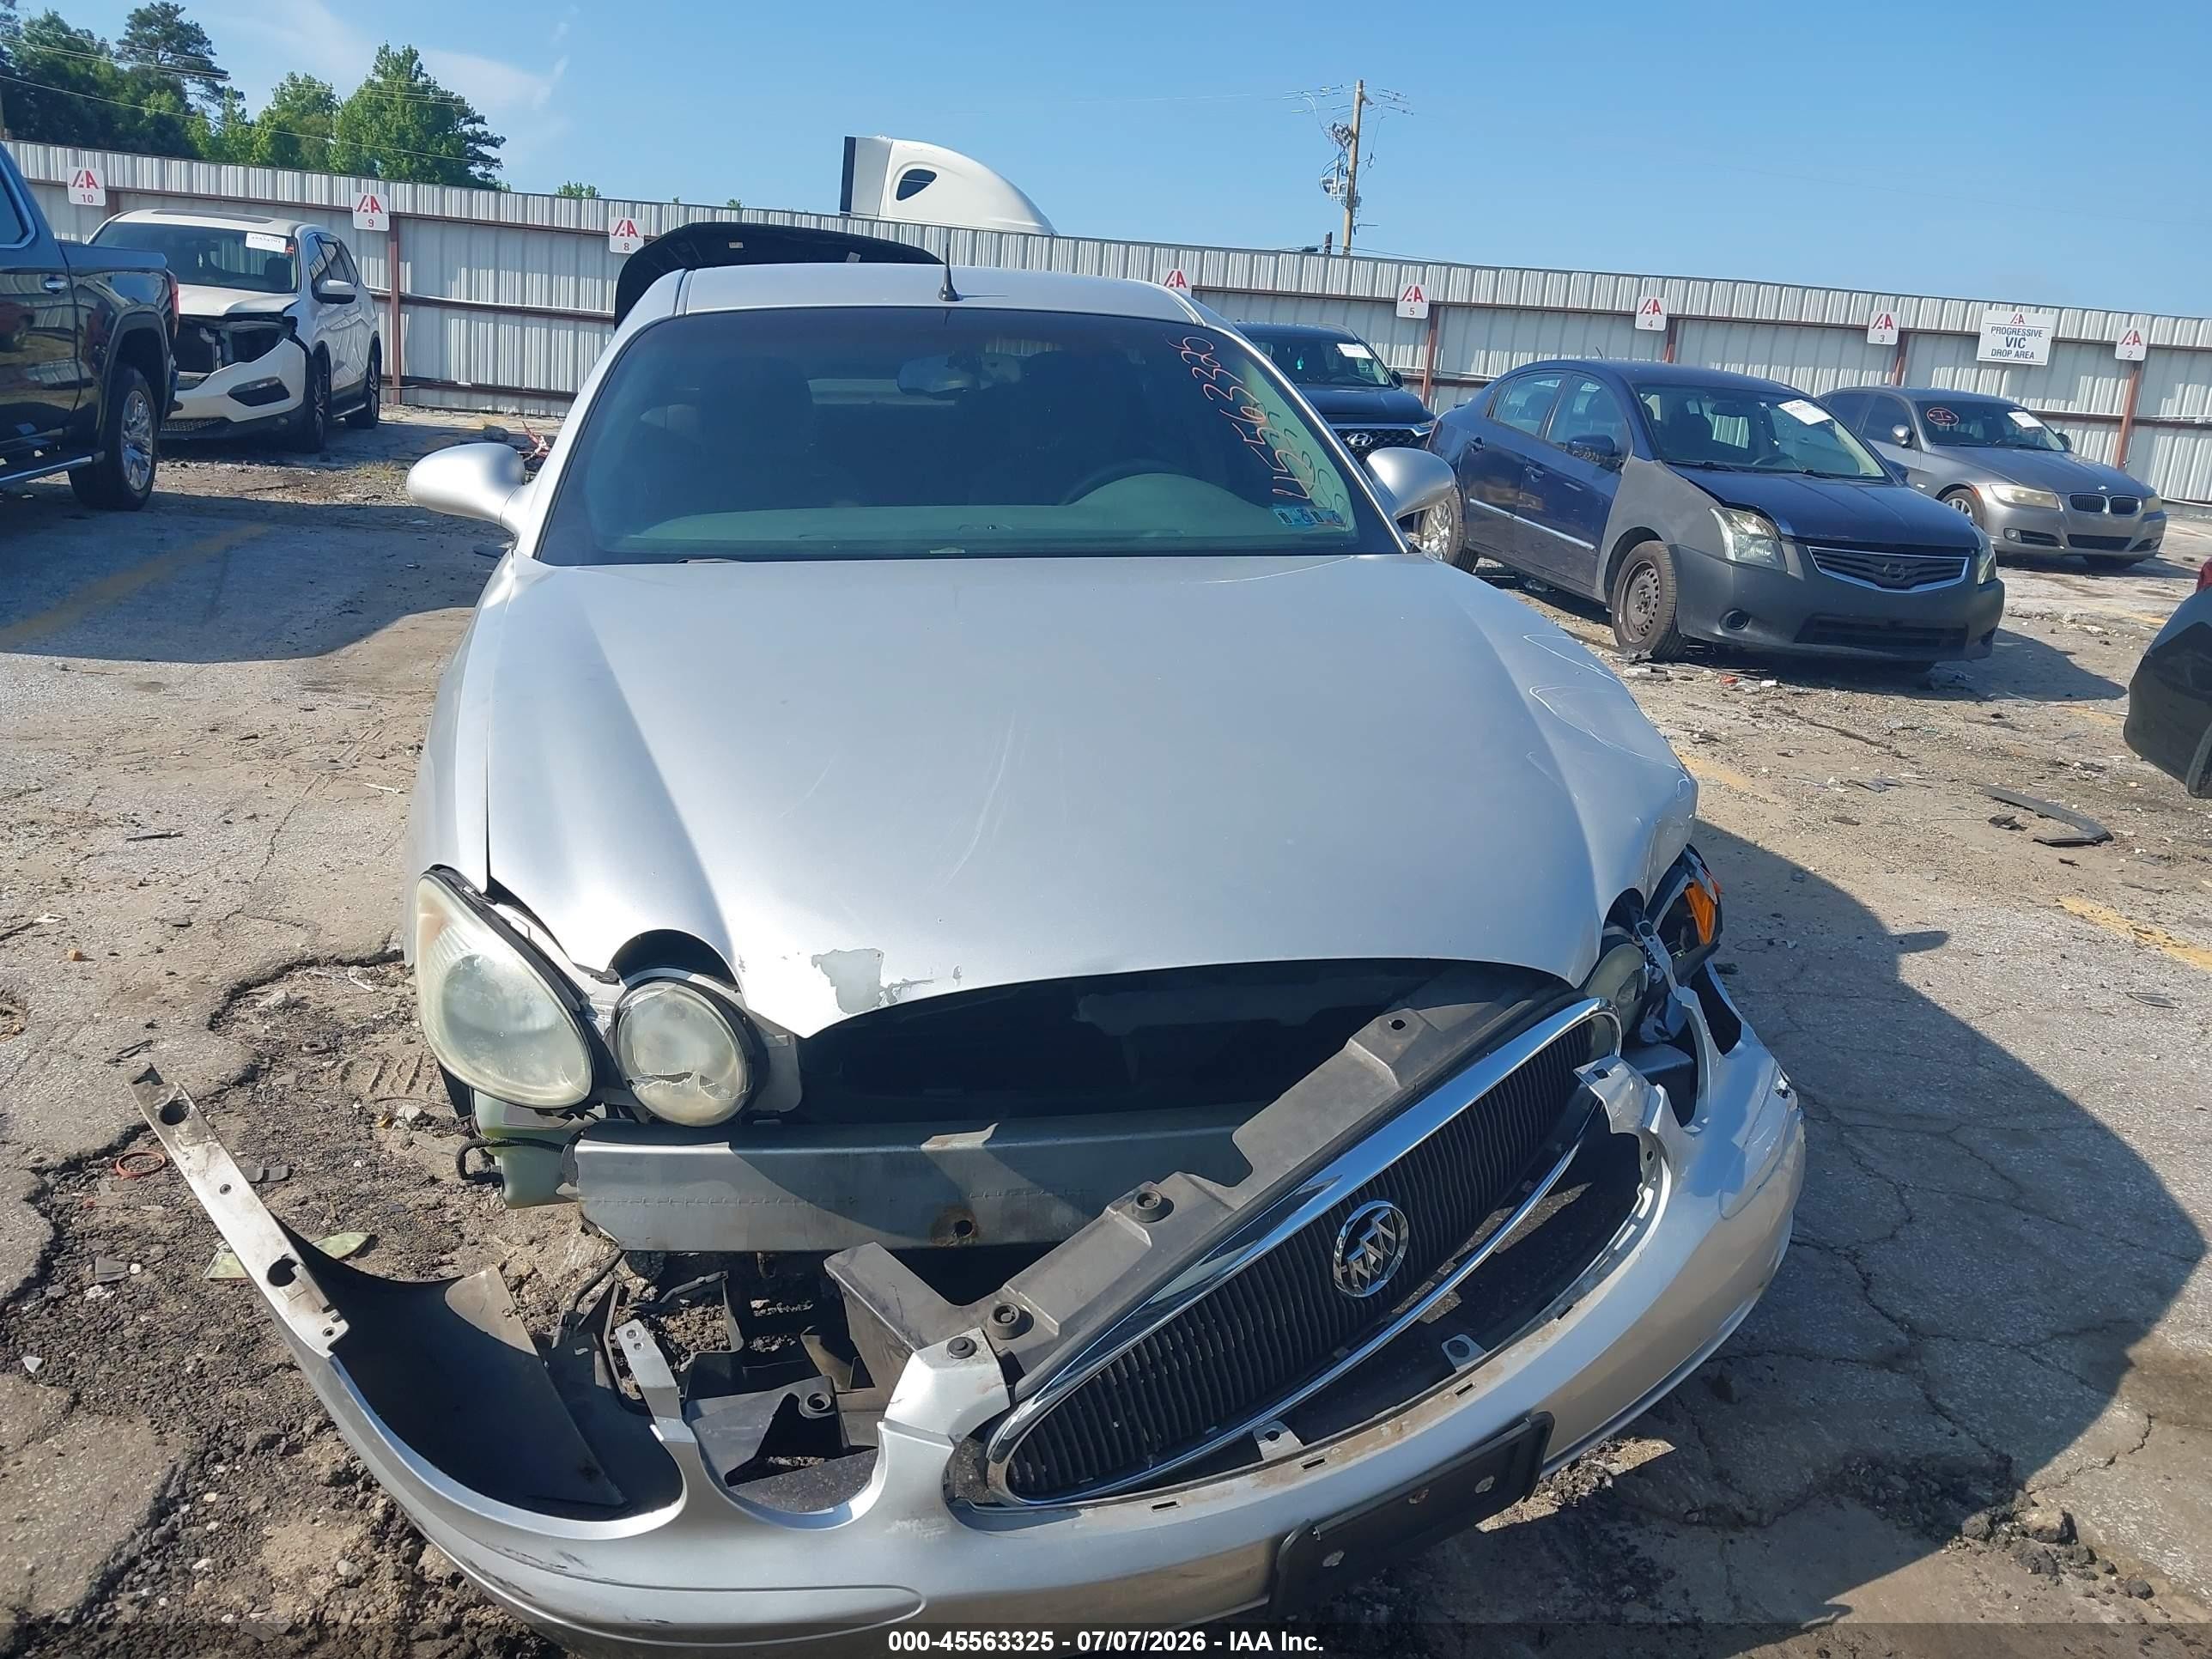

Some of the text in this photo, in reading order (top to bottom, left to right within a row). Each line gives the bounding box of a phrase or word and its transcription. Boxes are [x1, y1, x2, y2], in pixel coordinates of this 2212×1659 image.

[82, 194, 94, 204] 10
[368, 218, 374, 228] 9
[623, 242, 630, 252] 8
[1409, 307, 1415, 316] 5
[1648, 319, 1654, 328] 4
[1990, 325, 2044, 337] PROGRESSIVE
[1879, 334, 1886, 343] 3
[2005, 336, 2027, 349] VIC
[1990, 348, 2035, 360] DROP AREA
[2127, 349, 2134, 359] 2
